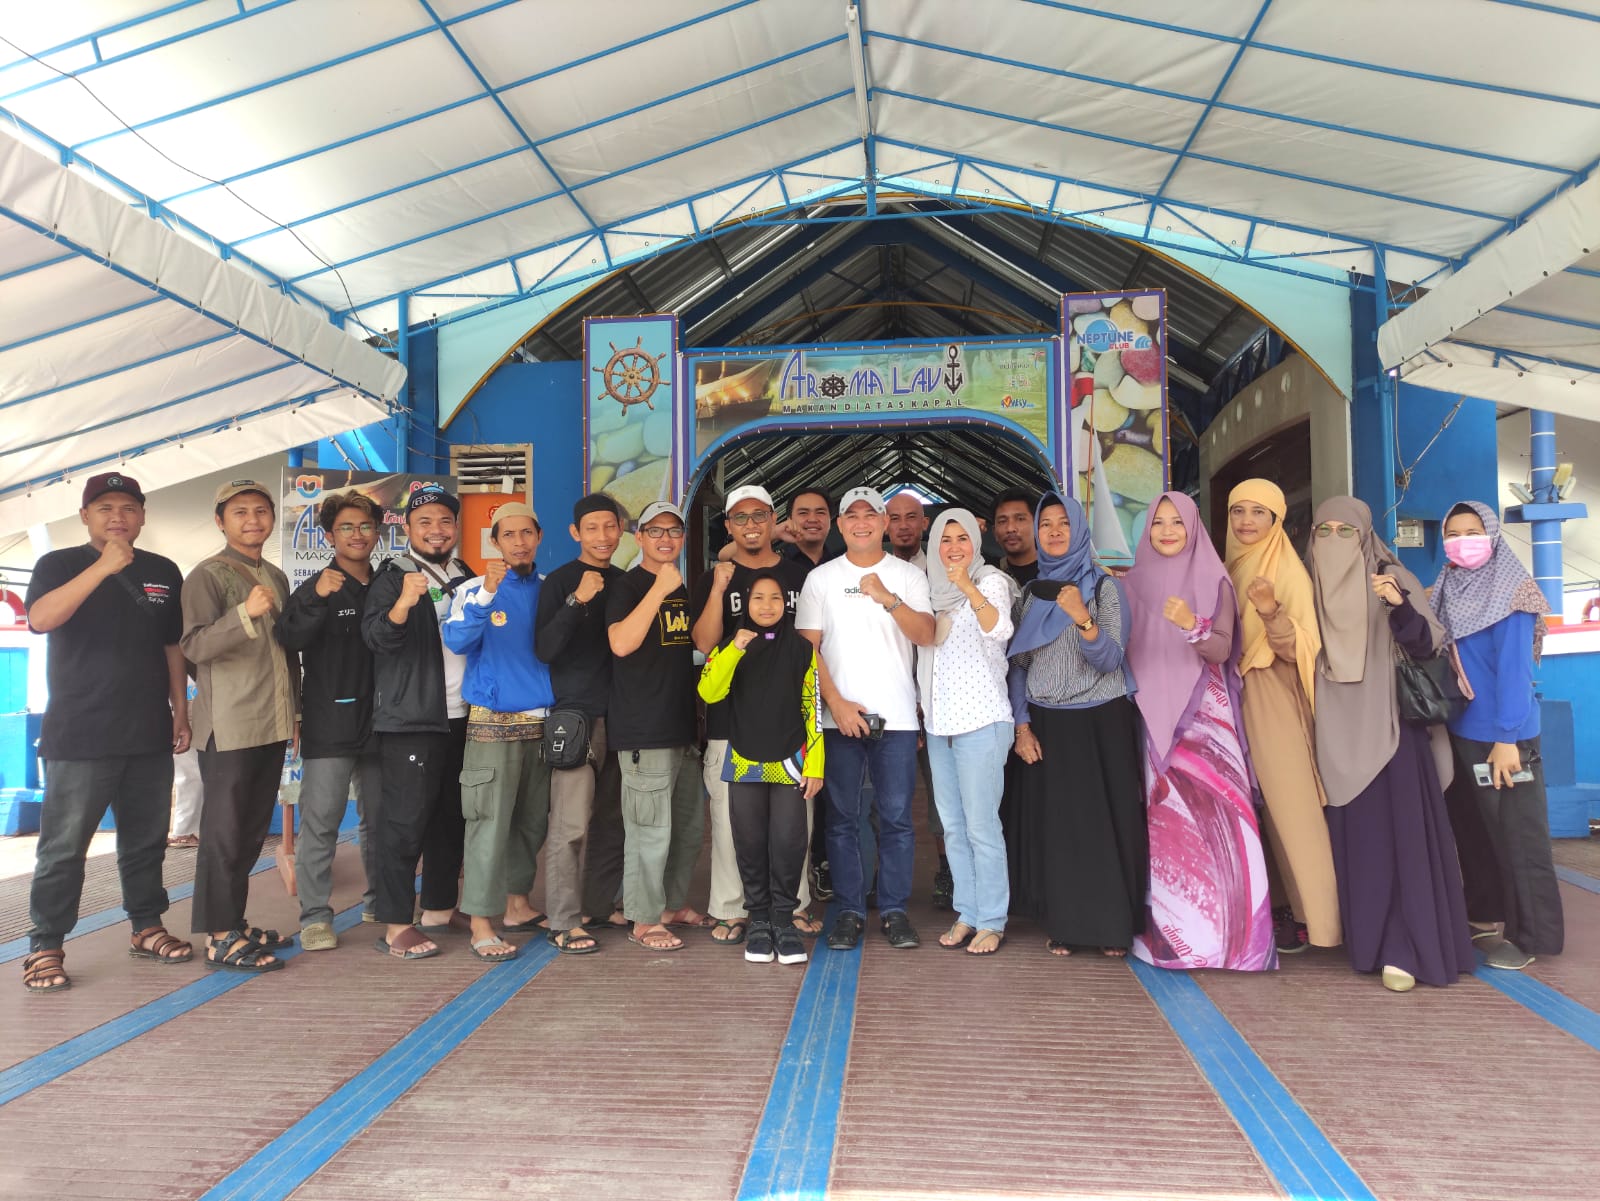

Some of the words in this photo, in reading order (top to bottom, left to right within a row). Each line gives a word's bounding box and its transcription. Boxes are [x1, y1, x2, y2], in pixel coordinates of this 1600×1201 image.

[1076, 331, 1134, 344] NEPTUNE
[1109, 342, 1130, 350] CLUB
[295, 551, 337, 561] MAKA
